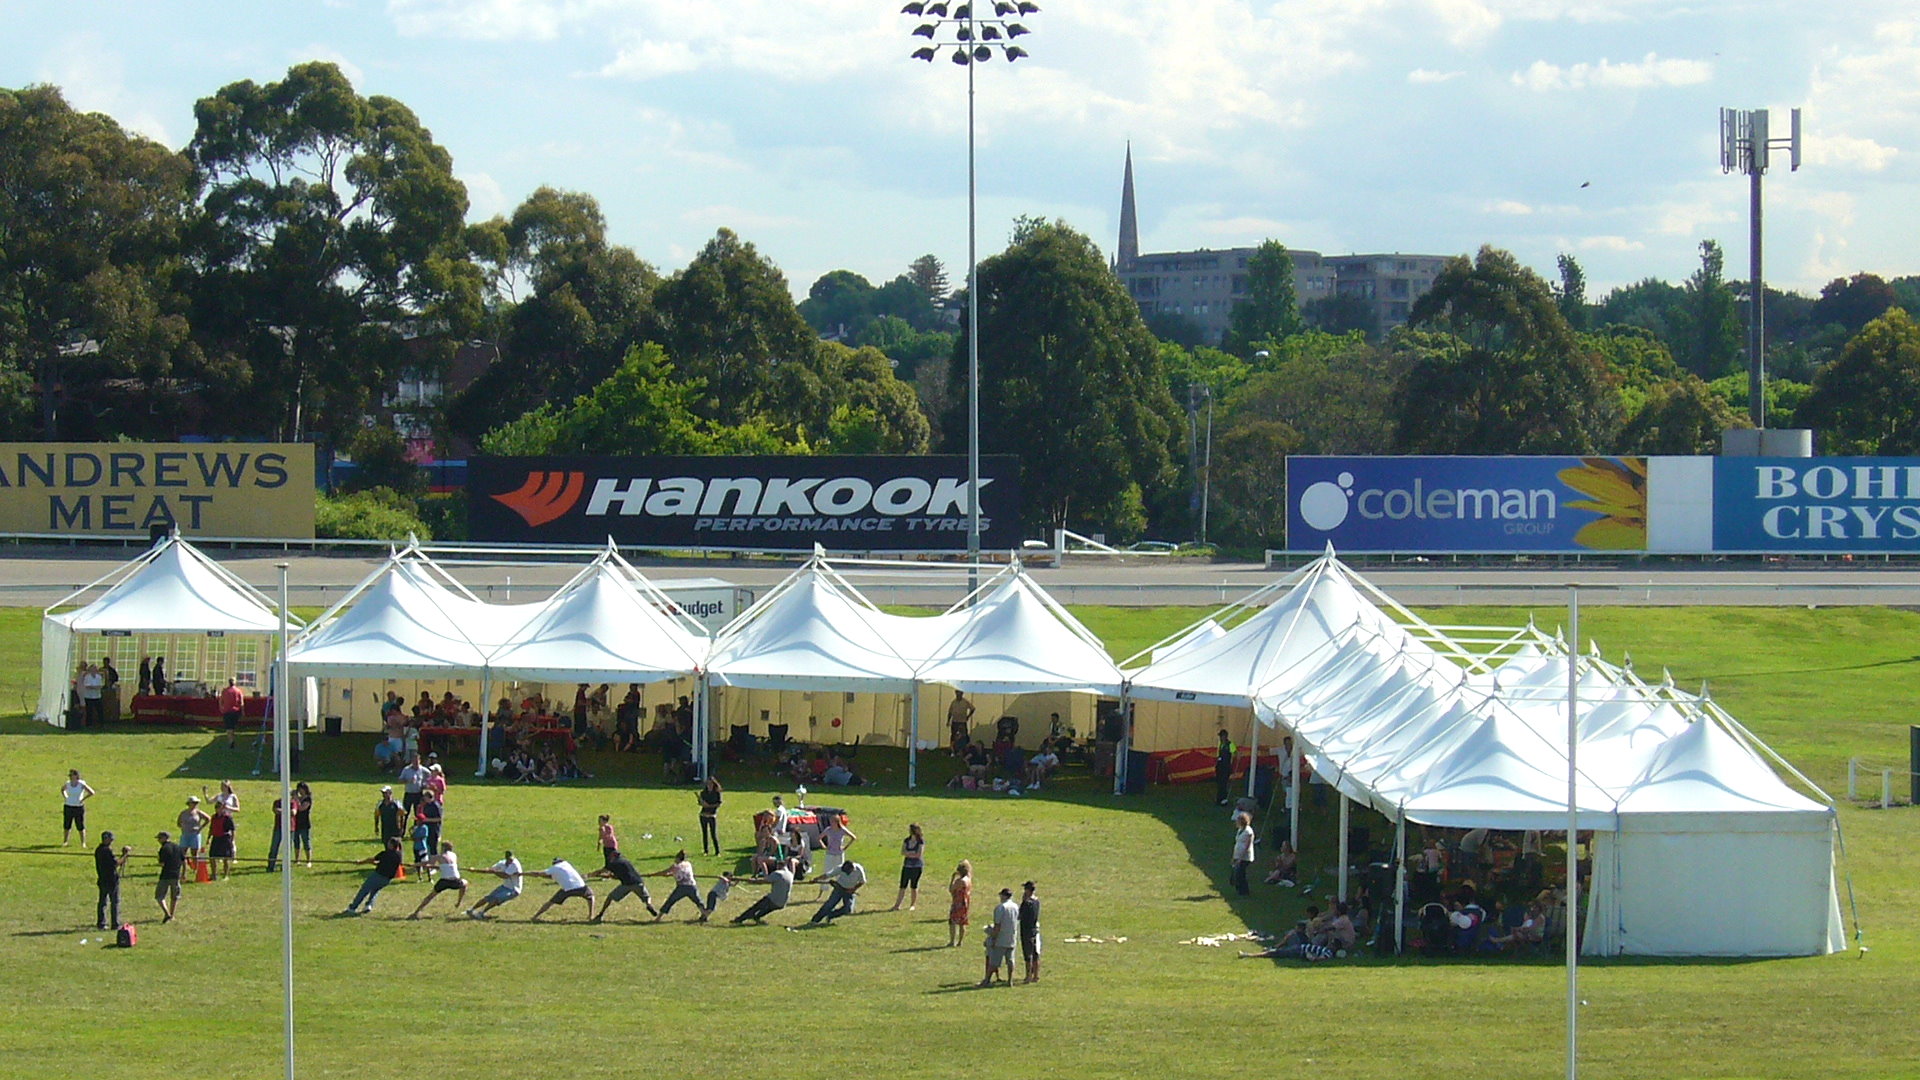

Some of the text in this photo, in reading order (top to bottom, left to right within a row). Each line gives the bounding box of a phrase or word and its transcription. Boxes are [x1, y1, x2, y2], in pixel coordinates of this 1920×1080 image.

[49, 494, 213, 530] MEAT
[1358, 478, 1556, 519] coleman
[694, 518, 992, 532] PERFORMANCE TYRES
[1503, 523, 1555, 535] GROUP
[1763, 505, 1920, 539] CRYS
